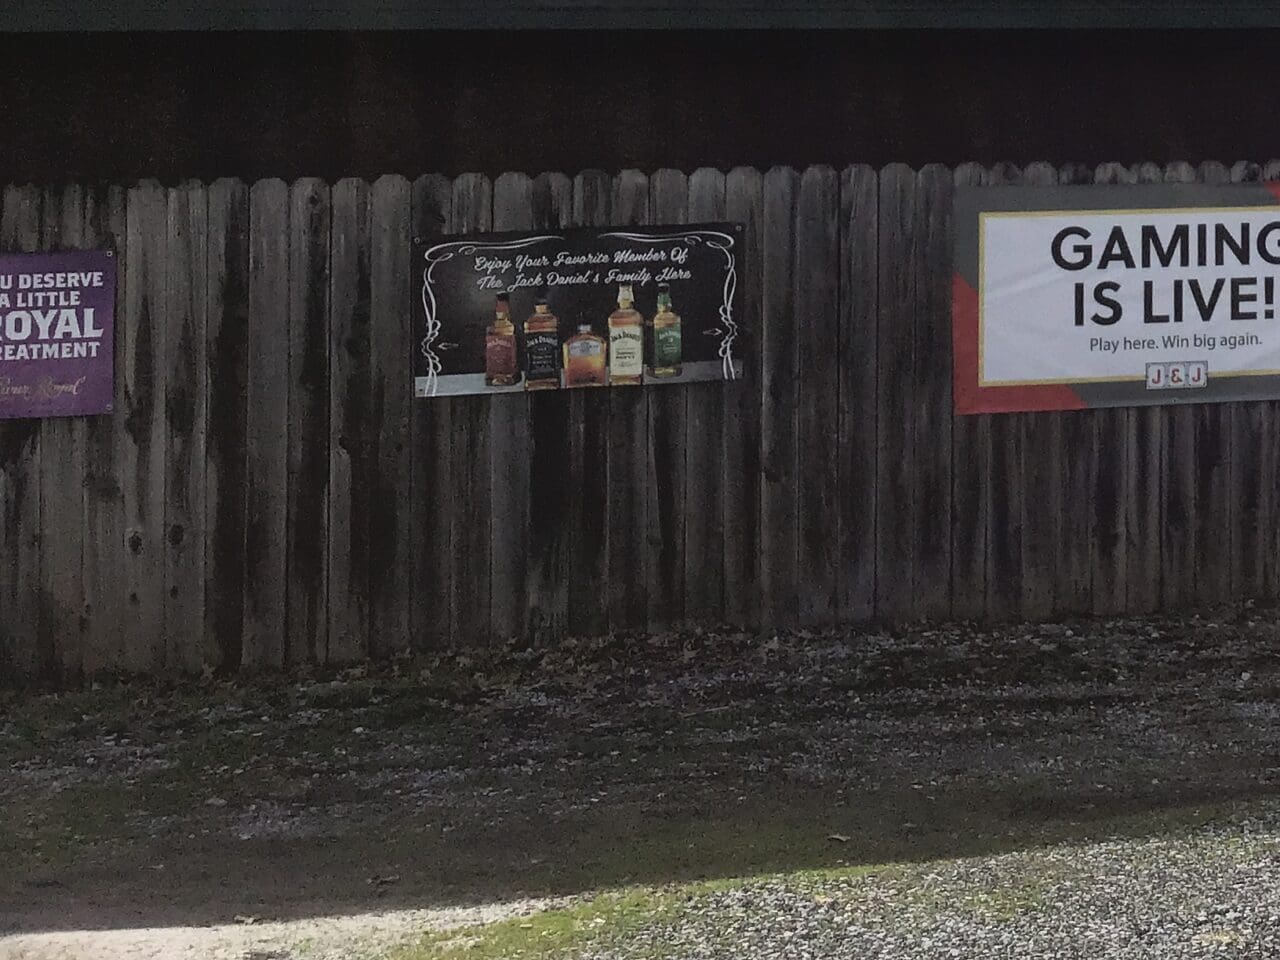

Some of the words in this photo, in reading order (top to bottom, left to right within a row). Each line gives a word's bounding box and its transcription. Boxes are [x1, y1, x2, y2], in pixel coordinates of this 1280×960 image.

[474, 256, 512, 274] Enjoy
[515, 254, 549, 272] Your
[553, 251, 609, 266] Favorite
[613, 247, 667, 263] Member
[671, 246, 689, 264] Of
[18, 271, 104, 289] DESERVE
[477, 274, 504, 290] The
[507, 272, 544, 292] Jack
[604, 267, 651, 286] Family
[655, 266, 692, 281] Here
[0, 292, 10, 308] A
[17, 290, 81, 308] LITTLE
[1073, 280, 1123, 327] IS
[1143, 276, 1275, 325] LIVE!
[0, 307, 104, 341] OYAL
[1089, 337, 1119, 354] Play
[1123, 337, 1159, 351] here.
[1162, 335, 1190, 349] Win
[1193, 334, 1216, 350] big
[1219, 332, 1263, 350] again.
